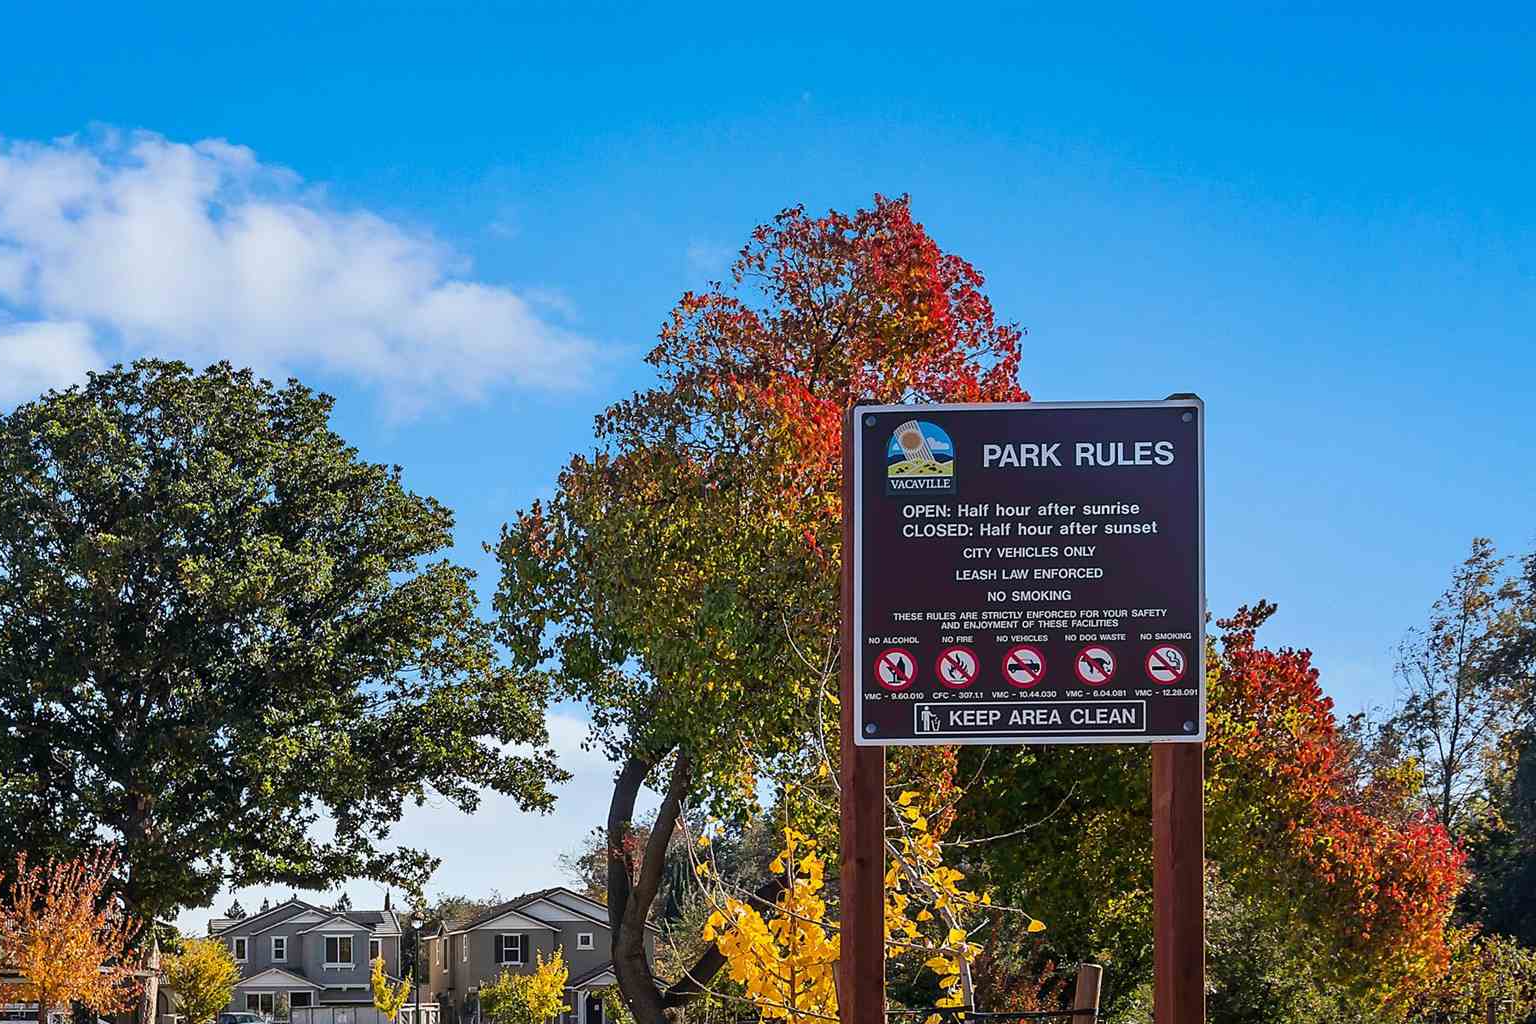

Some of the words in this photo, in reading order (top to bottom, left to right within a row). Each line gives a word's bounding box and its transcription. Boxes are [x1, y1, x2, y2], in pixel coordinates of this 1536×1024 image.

[984, 443, 1061, 467] PARK
[1076, 441, 1174, 466] RULES
[891, 479, 950, 489] VACAVILLE
[903, 505, 950, 518] OPEN:
[958, 504, 989, 517] Half
[996, 504, 1031, 516] hour
[1038, 503, 1076, 515] after
[1083, 502, 1139, 515] sunrise
[903, 524, 973, 537] CLOSED:
[980, 523, 1010, 536] Half
[1018, 523, 1053, 535] hour
[1060, 522, 1098, 535] after
[1105, 521, 1157, 534] sunset
[964, 548, 992, 558] CITY
[997, 547, 1058, 557] VEHICLES
[1064, 546, 1095, 556] ONLY
[956, 570, 996, 580] LEASH
[1002, 569, 1029, 579] LAW
[1034, 568, 1103, 579] ENFORCED
[988, 591, 1006, 601] NO
[1012, 590, 1071, 601] SMOKING
[893, 612, 923, 621] THESE
[926, 612, 957, 621] RULES
[960, 612, 979, 620] ARE
[982, 611, 1023, 619] STRICTLY
[1027, 610, 1076, 618] ENFORCED
[1080, 610, 1099, 618] FOR
[1103, 609, 1127, 617] YOUR
[1132, 609, 1167, 617] SAFETY
[941, 621, 960, 630] AND
[964, 621, 1018, 629] ENJOYMENT
[1038, 620, 1068, 628] THESE
[1071, 619, 1119, 628] FACILITIES
[869, 637, 880, 645] NO
[942, 636, 953, 644] NO
[957, 636, 973, 644] FIRE
[997, 635, 1008, 643] NO
[1080, 634, 1097, 642] DOG
[1140, 633, 1152, 641] NO
[1155, 633, 1191, 641] SMOKING
[865, 693, 881, 701] VMC
[933, 692, 949, 700] CFC
[992, 691, 1009, 699] VMC
[1066, 690, 1083, 698] VMC
[950, 711, 1000, 726] KEEP
[1009, 709, 1062, 725] AREA
[1071, 708, 1135, 724] CLEAN
